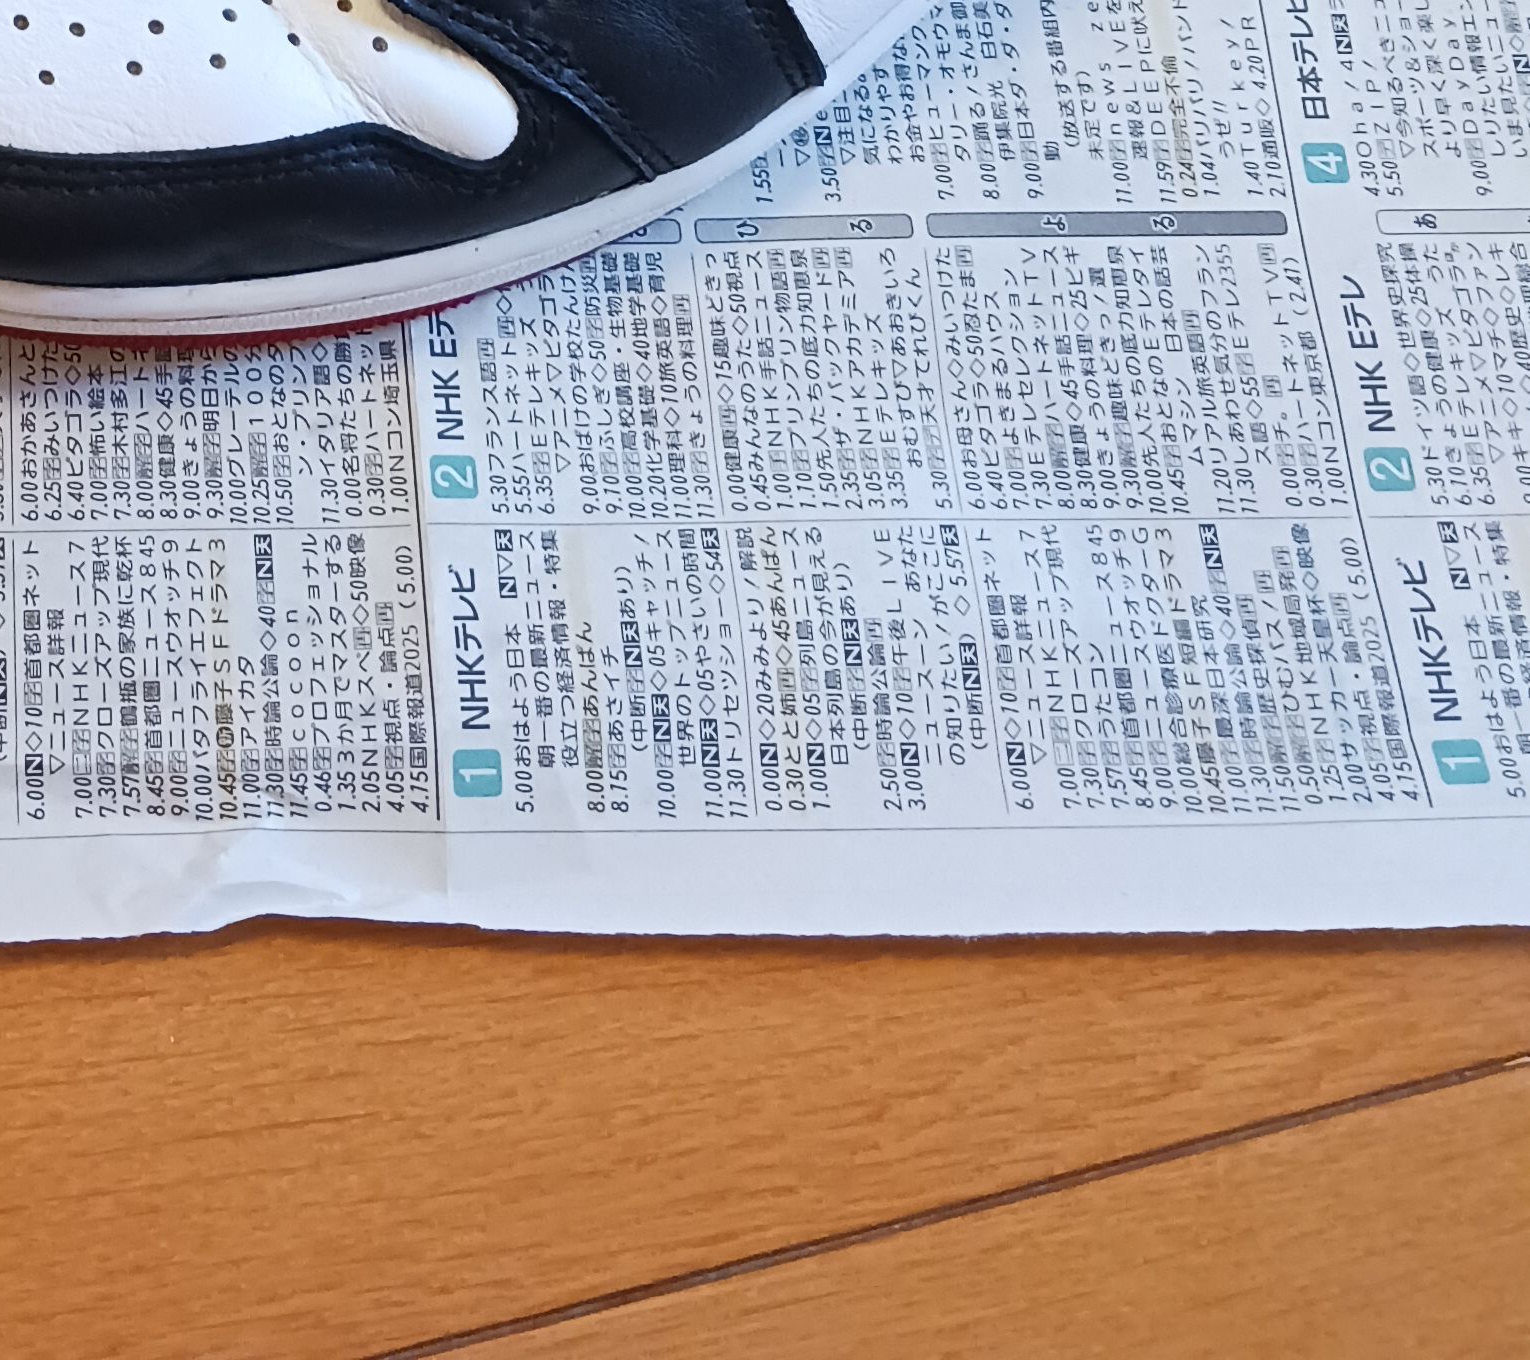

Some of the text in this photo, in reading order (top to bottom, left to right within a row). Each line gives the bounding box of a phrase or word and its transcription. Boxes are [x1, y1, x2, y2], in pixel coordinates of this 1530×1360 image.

[988, 81, 1016, 161] 伊集院光
[1150, 245, 1184, 354] 日本の話芸
[1340, 274, 1395, 432] NHK Eテレ
[433, 371, 465, 441] NHK
[448, 566, 491, 731] NHKテレビ
[519, 530, 555, 768] 朝一番の最新ニュース
[806, 527, 850, 765] 日本列島の今が見える
[1397, 558, 1462, 722] NHKテレビ
